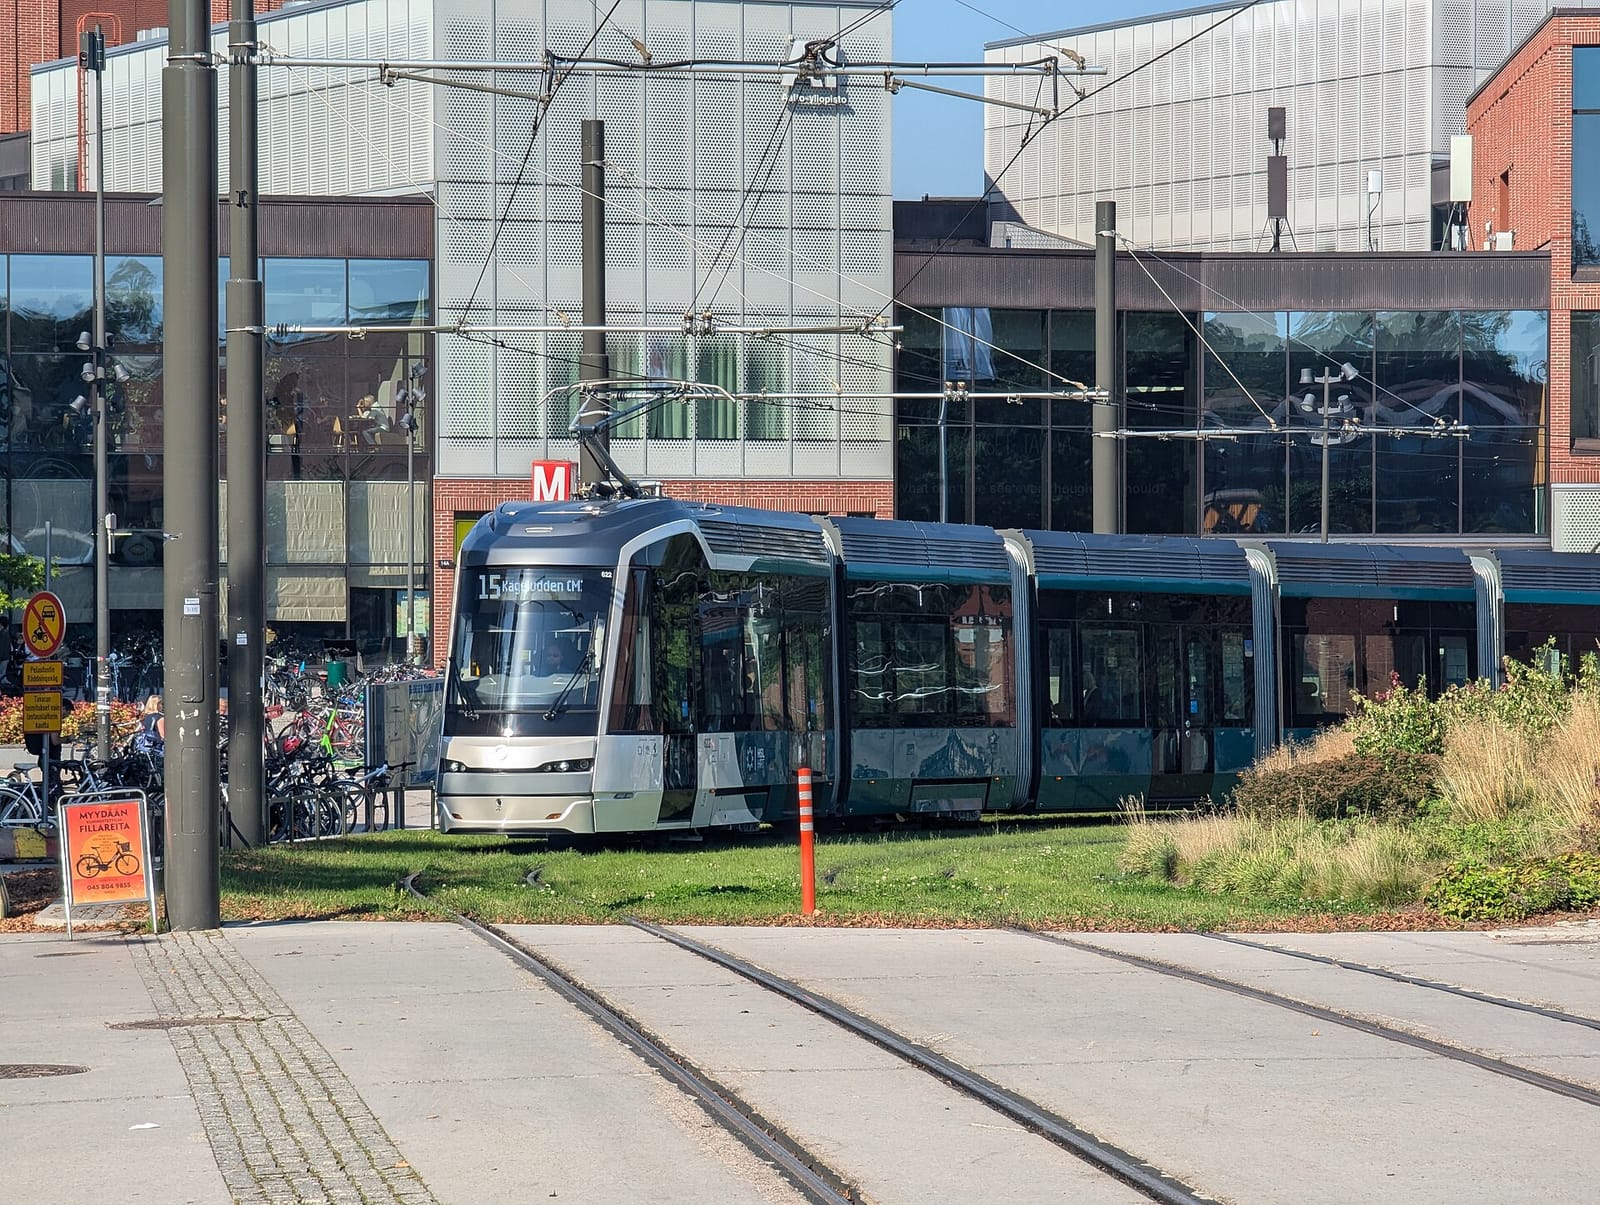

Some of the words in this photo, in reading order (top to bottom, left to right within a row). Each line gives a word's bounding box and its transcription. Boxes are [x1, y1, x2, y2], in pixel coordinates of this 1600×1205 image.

[533, 465, 566, 501] M
[479, 574, 501, 599] 15
[79, 808, 128, 820] MYYDÄÄN
[79, 822, 131, 833] FILLAREITA
